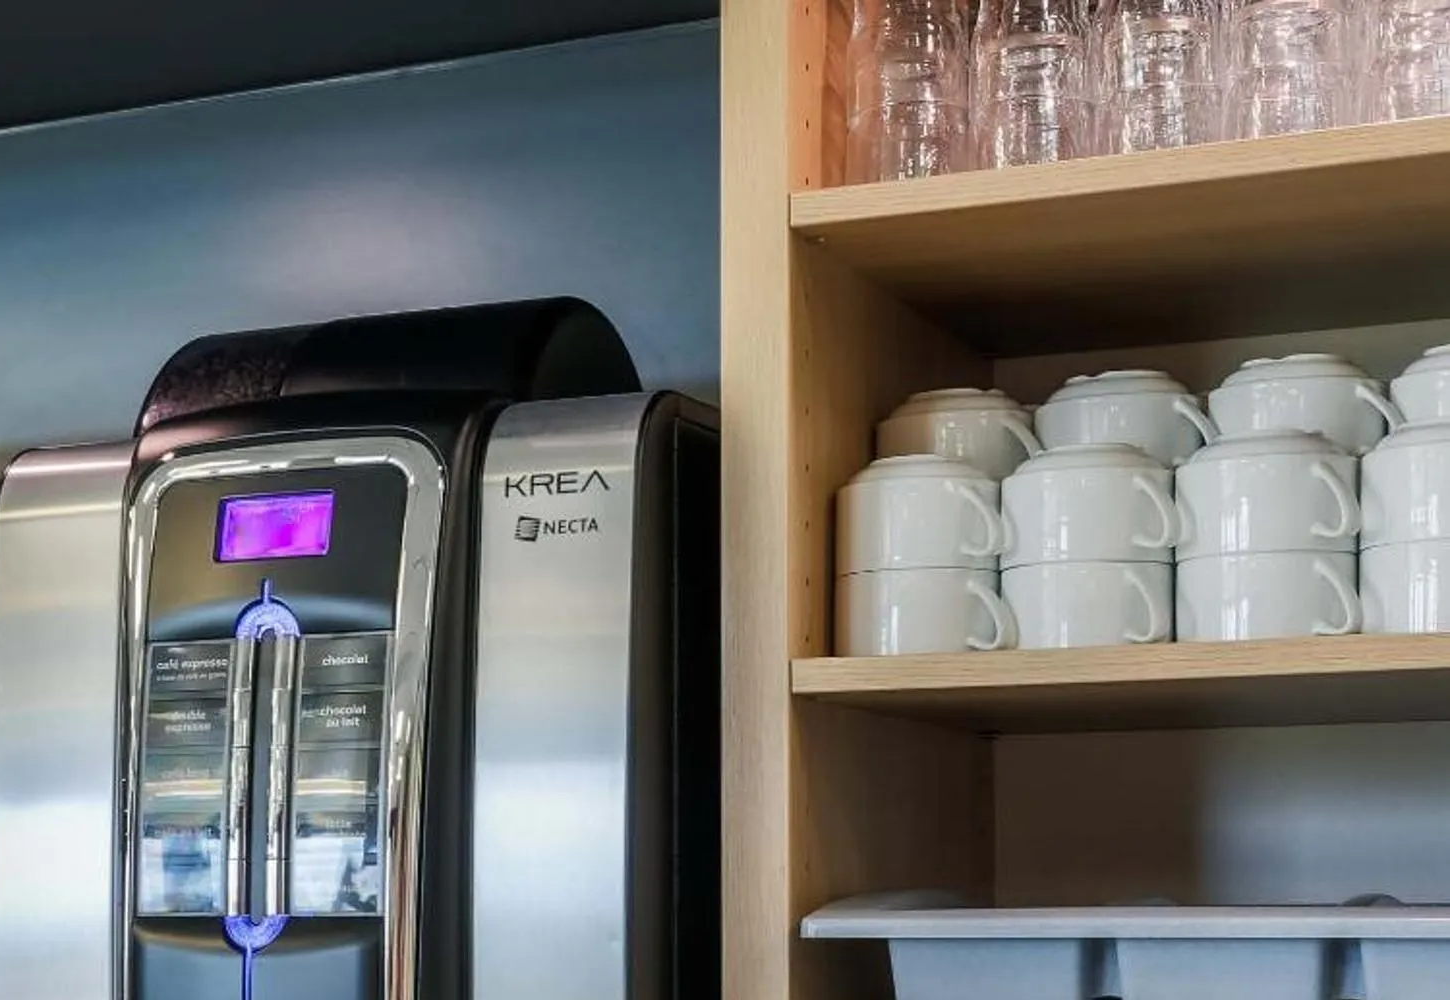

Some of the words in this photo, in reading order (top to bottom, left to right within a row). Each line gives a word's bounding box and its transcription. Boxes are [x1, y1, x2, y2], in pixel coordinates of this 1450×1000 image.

[543, 517, 598, 534] NECTA
[321, 654, 369, 666] chocolat
[320, 704, 367, 716] chocolat
